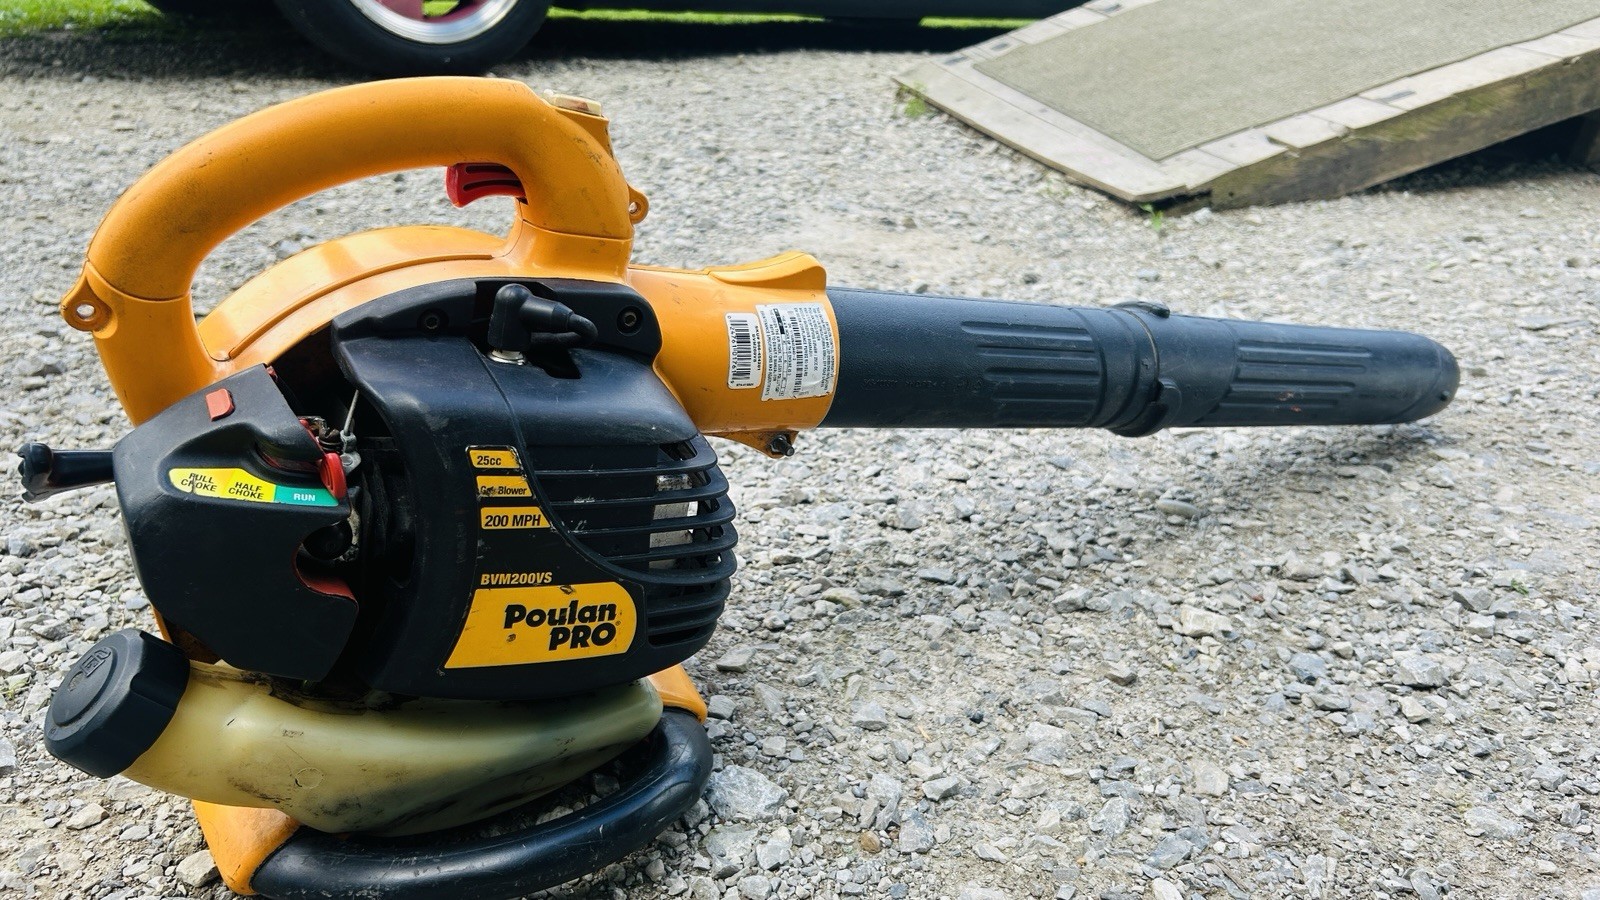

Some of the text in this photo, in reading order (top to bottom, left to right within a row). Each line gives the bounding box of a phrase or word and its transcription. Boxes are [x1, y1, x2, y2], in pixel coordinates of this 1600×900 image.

[477, 455, 502, 466] 25cc
[180, 478, 217, 492] CHOKE
[234, 481, 263, 492] HALF
[497, 485, 528, 496] Blower
[228, 487, 264, 500] CHOKE
[293, 492, 316, 502] RUN
[484, 514, 542, 527] 200 MPH
[480, 571, 553, 586] BVM200VS
[503, 599, 617, 629] Poulan
[548, 622, 617, 651] PRO
